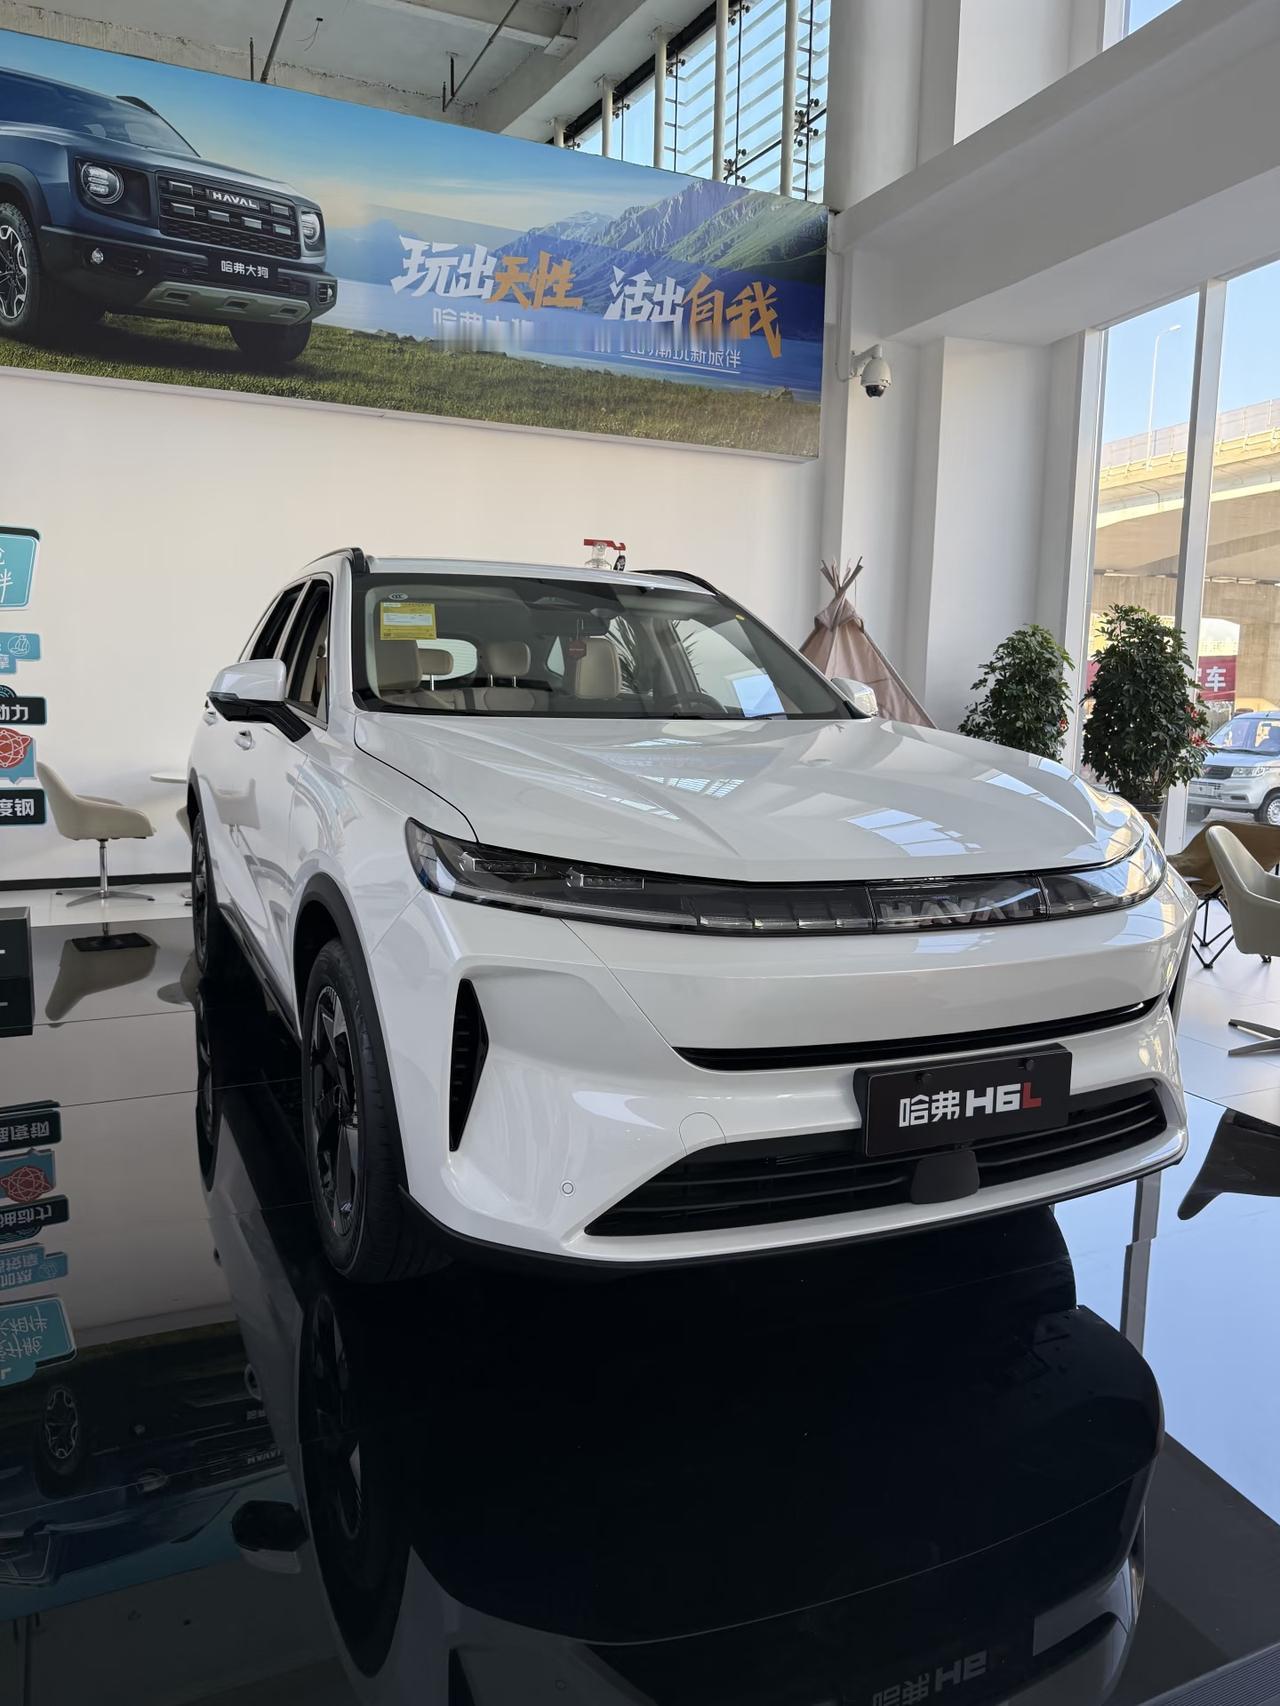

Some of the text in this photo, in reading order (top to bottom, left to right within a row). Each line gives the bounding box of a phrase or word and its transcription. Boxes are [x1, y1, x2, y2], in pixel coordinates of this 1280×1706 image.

[212, 192, 257, 208] HAVAL
[220, 260, 269, 279] 哈弗大狗
[390, 235, 782, 358] 玩出天性 活出自我
[1197, 666, 1227, 692] 车
[879, 897, 1034, 924] HAVAL
